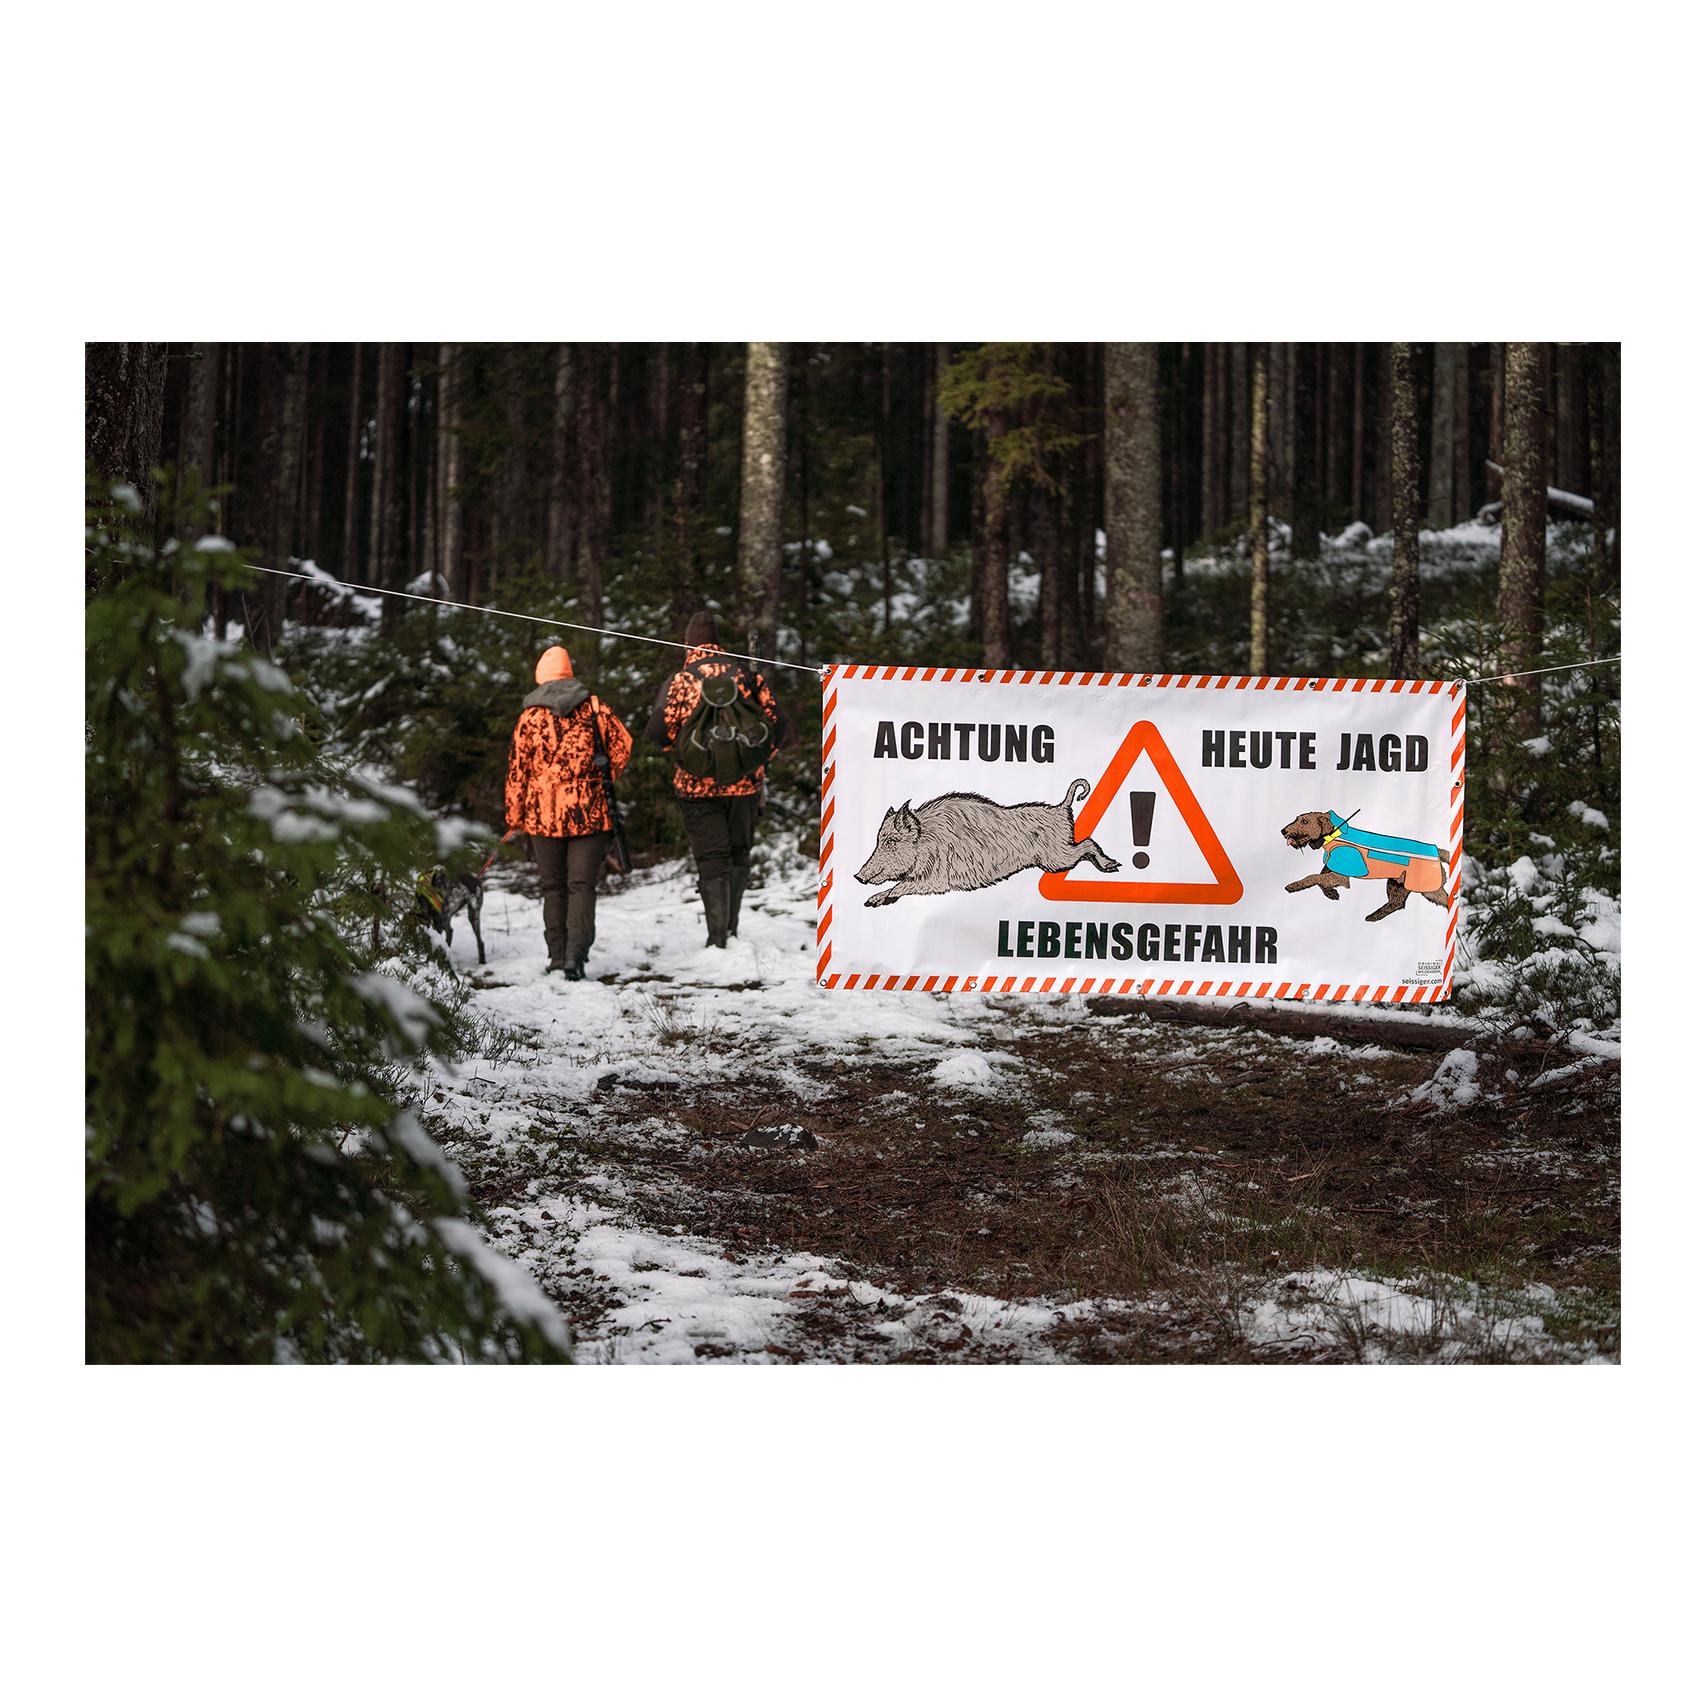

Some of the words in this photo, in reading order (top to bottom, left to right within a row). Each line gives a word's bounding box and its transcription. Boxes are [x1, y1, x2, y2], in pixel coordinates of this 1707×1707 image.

[874, 721, 1055, 763] ACHTUNG
[1202, 730, 1316, 769] HEUTE
[1337, 733, 1428, 772] JAGD
[998, 921, 1277, 964] LEBENSGEFAHR
[1401, 977, 1442, 985] seissiger.com
